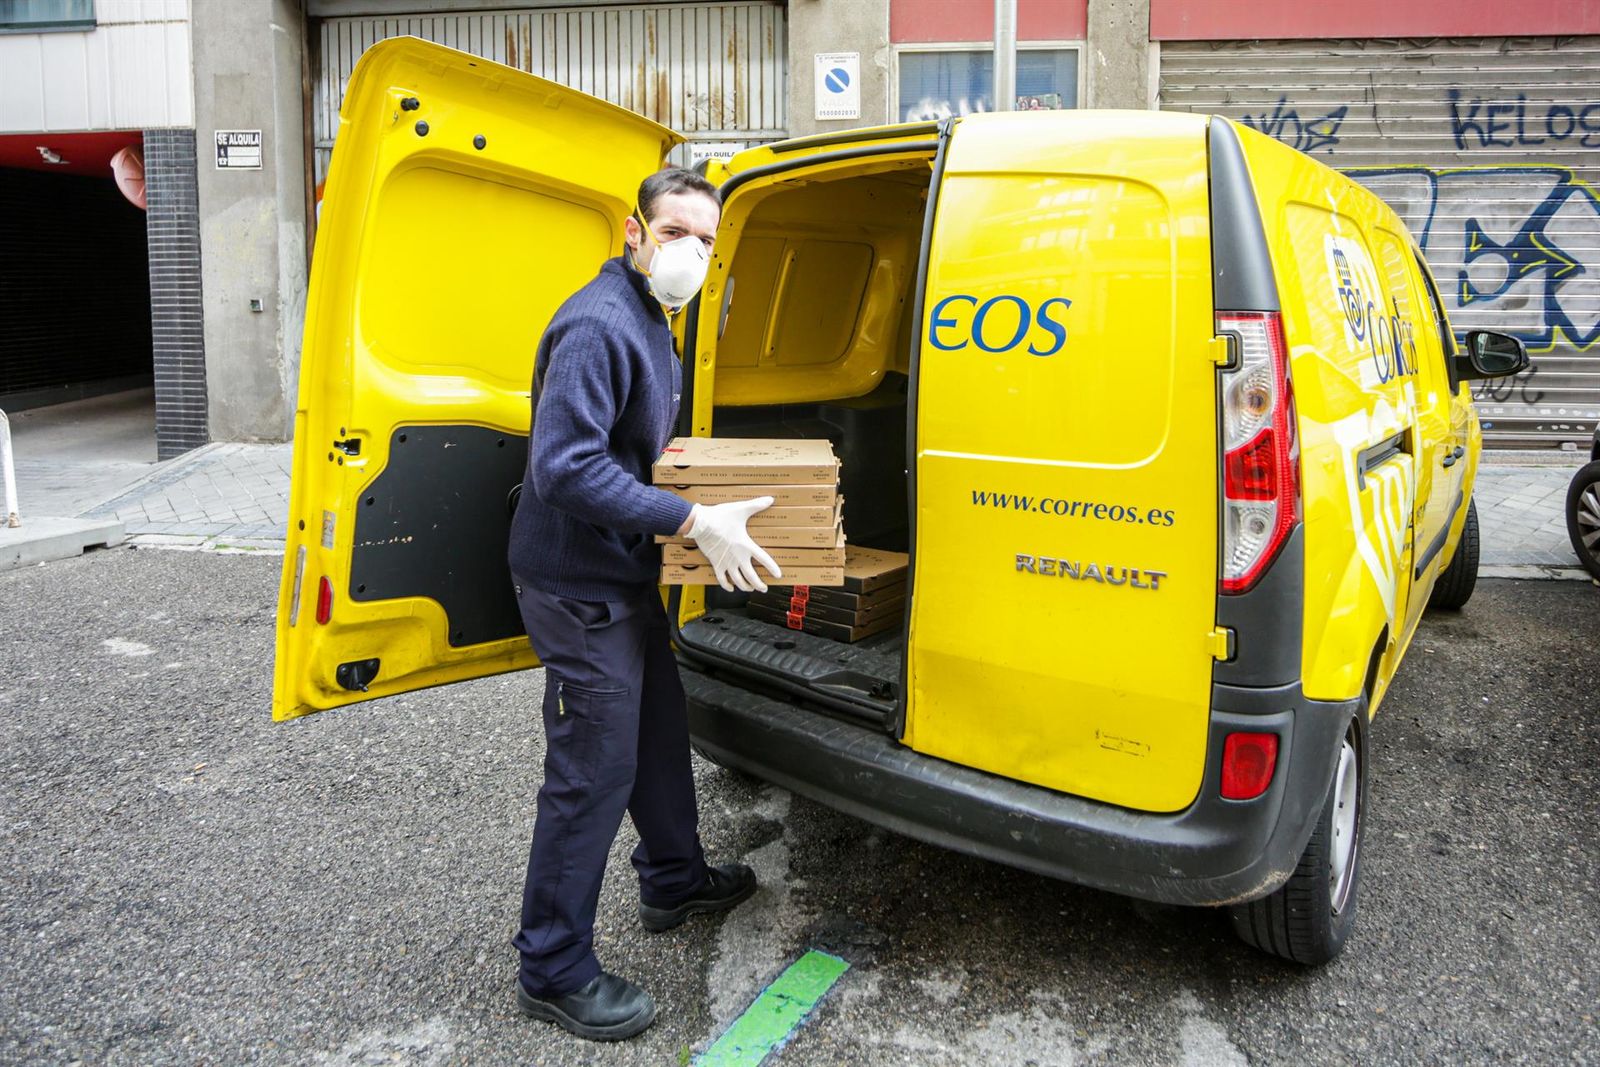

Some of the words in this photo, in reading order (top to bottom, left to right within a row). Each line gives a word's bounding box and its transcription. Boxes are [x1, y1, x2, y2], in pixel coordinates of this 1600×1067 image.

[217, 133, 228, 145] SE
[229, 133, 259, 145] ALQUILA
[971, 489, 1176, 527] www.correos.es
[1015, 552, 1168, 591] RENAULT
